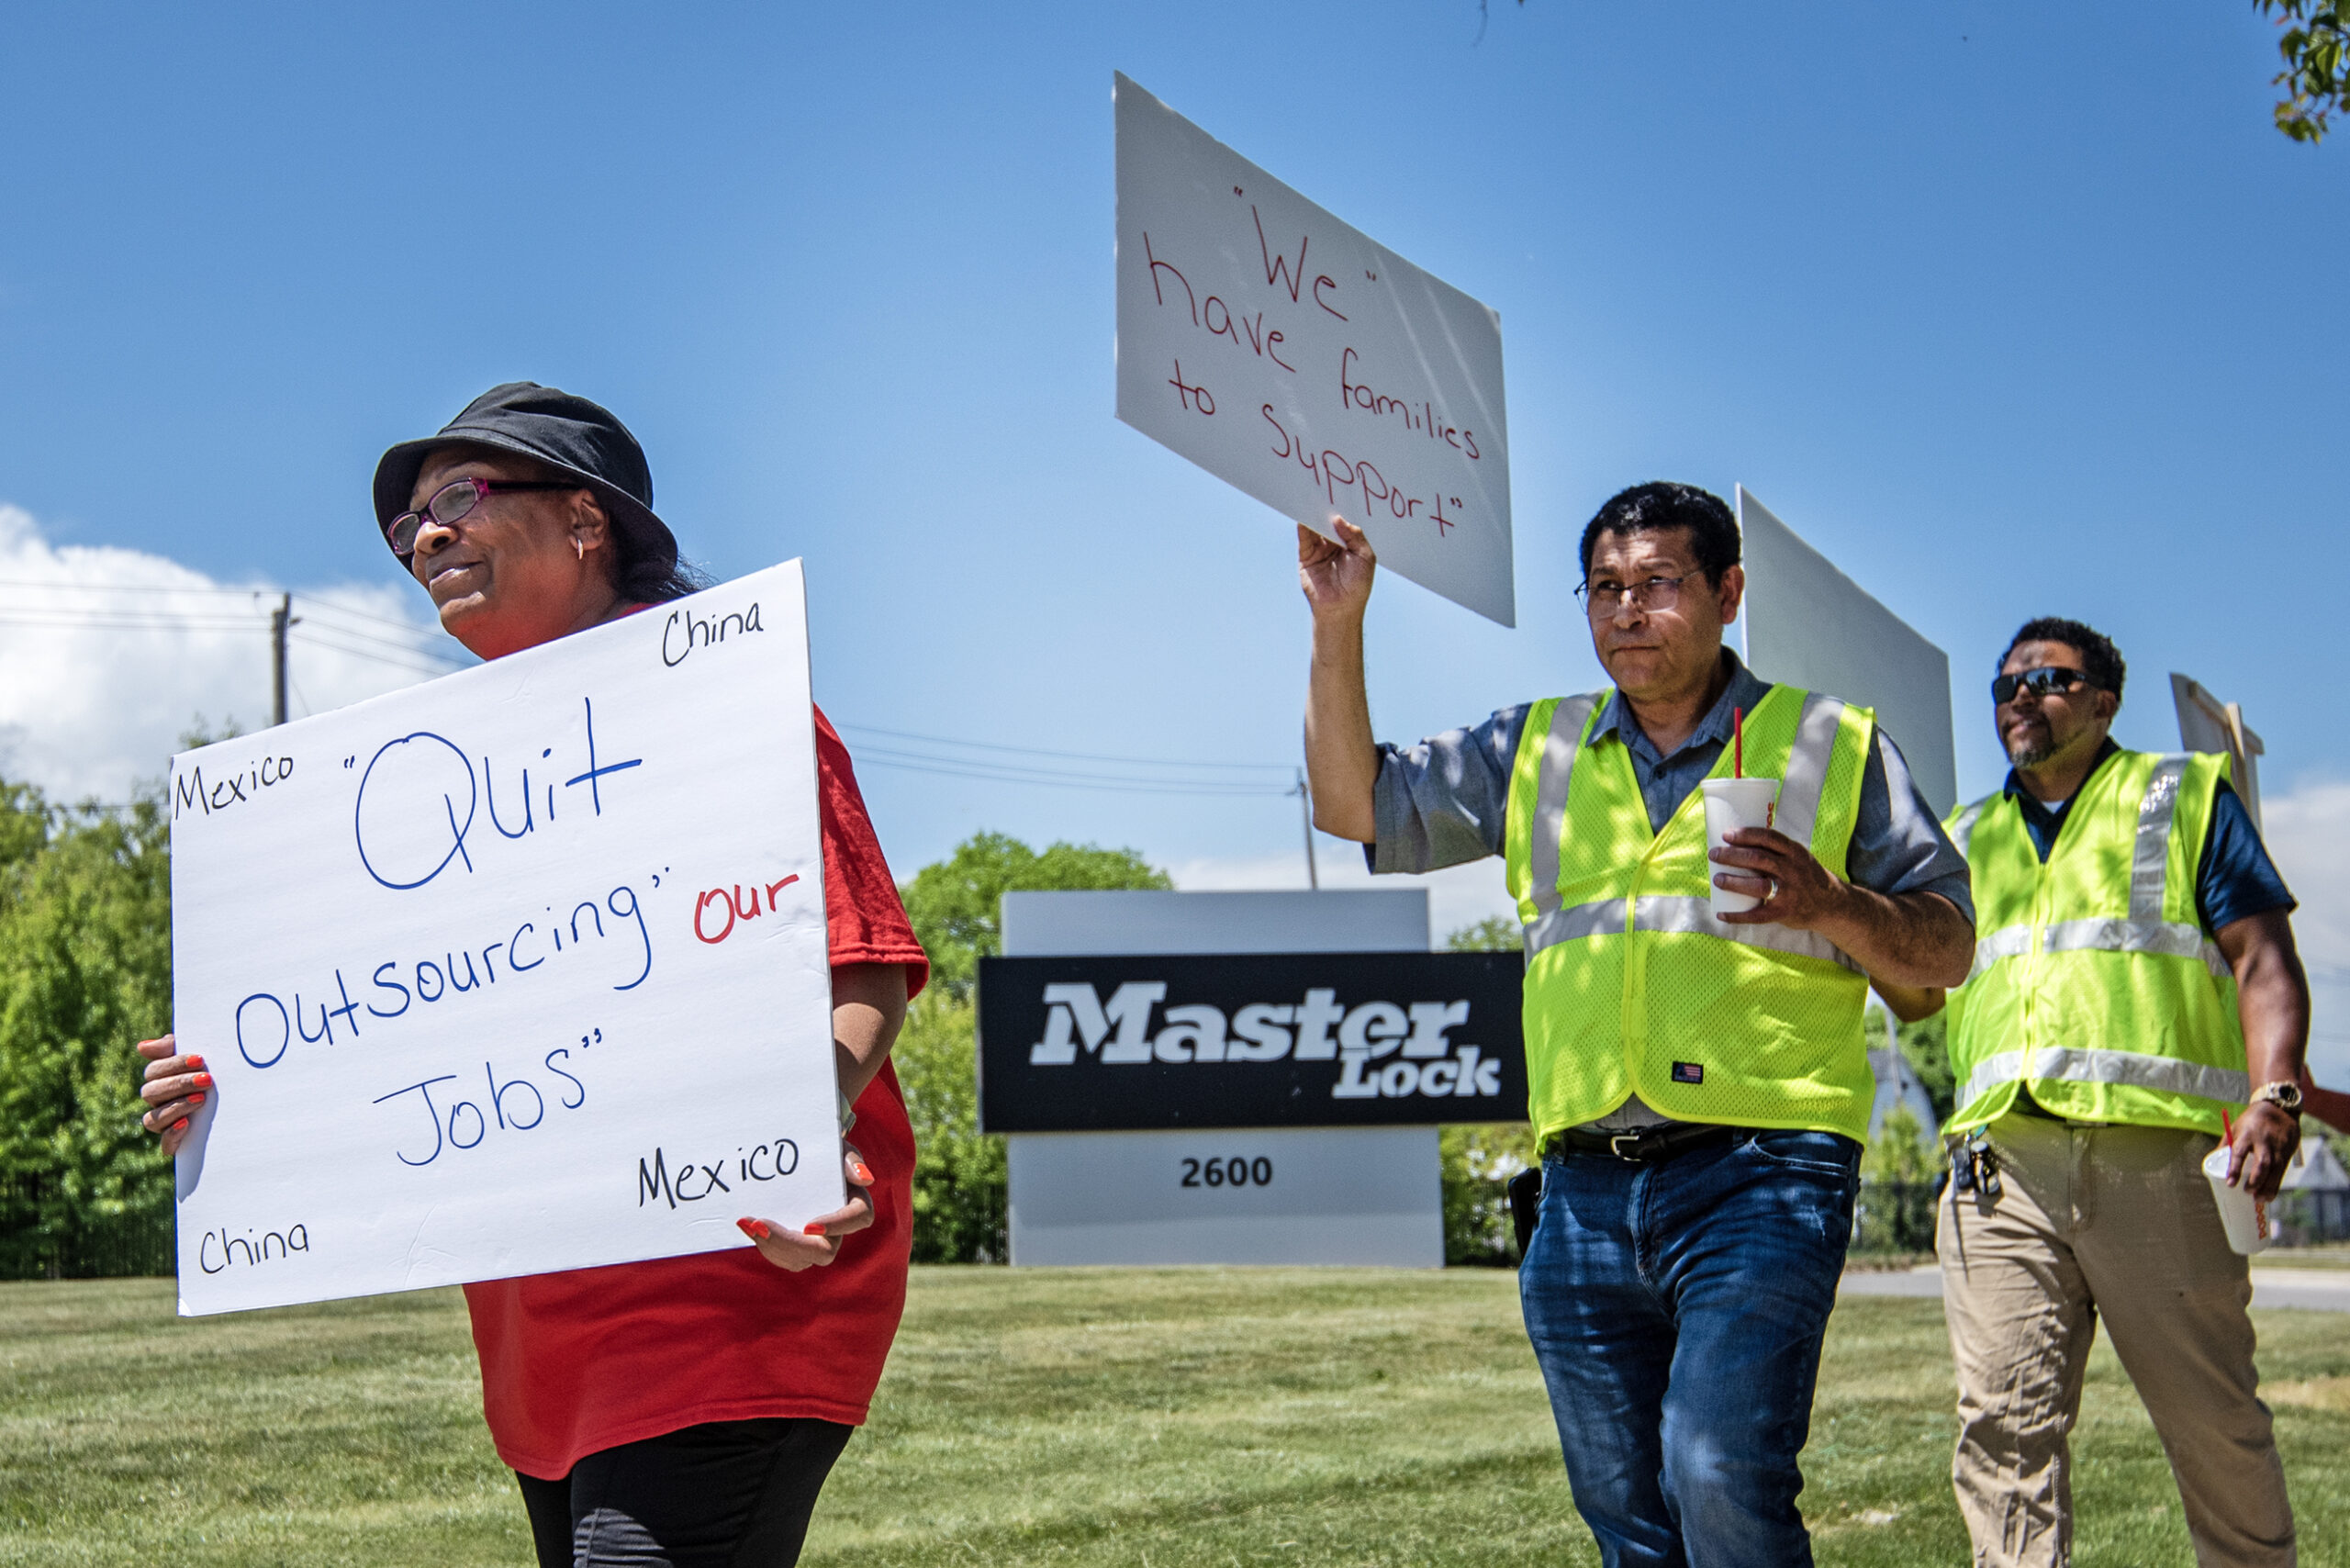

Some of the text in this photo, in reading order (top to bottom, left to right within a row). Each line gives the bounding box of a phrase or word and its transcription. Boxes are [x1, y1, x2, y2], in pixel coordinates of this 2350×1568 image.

[1144, 231, 1480, 459] have families
[1169, 359, 1215, 415] to
[663, 602, 764, 666] China
[174, 756, 294, 820] Mexico
[1029, 981, 1469, 1065] Master
[1332, 1046, 1501, 1099] Lock
[640, 1138, 799, 1210] Mexico
[1181, 1157, 1273, 1188] 2600
[200, 1224, 309, 1275] China
